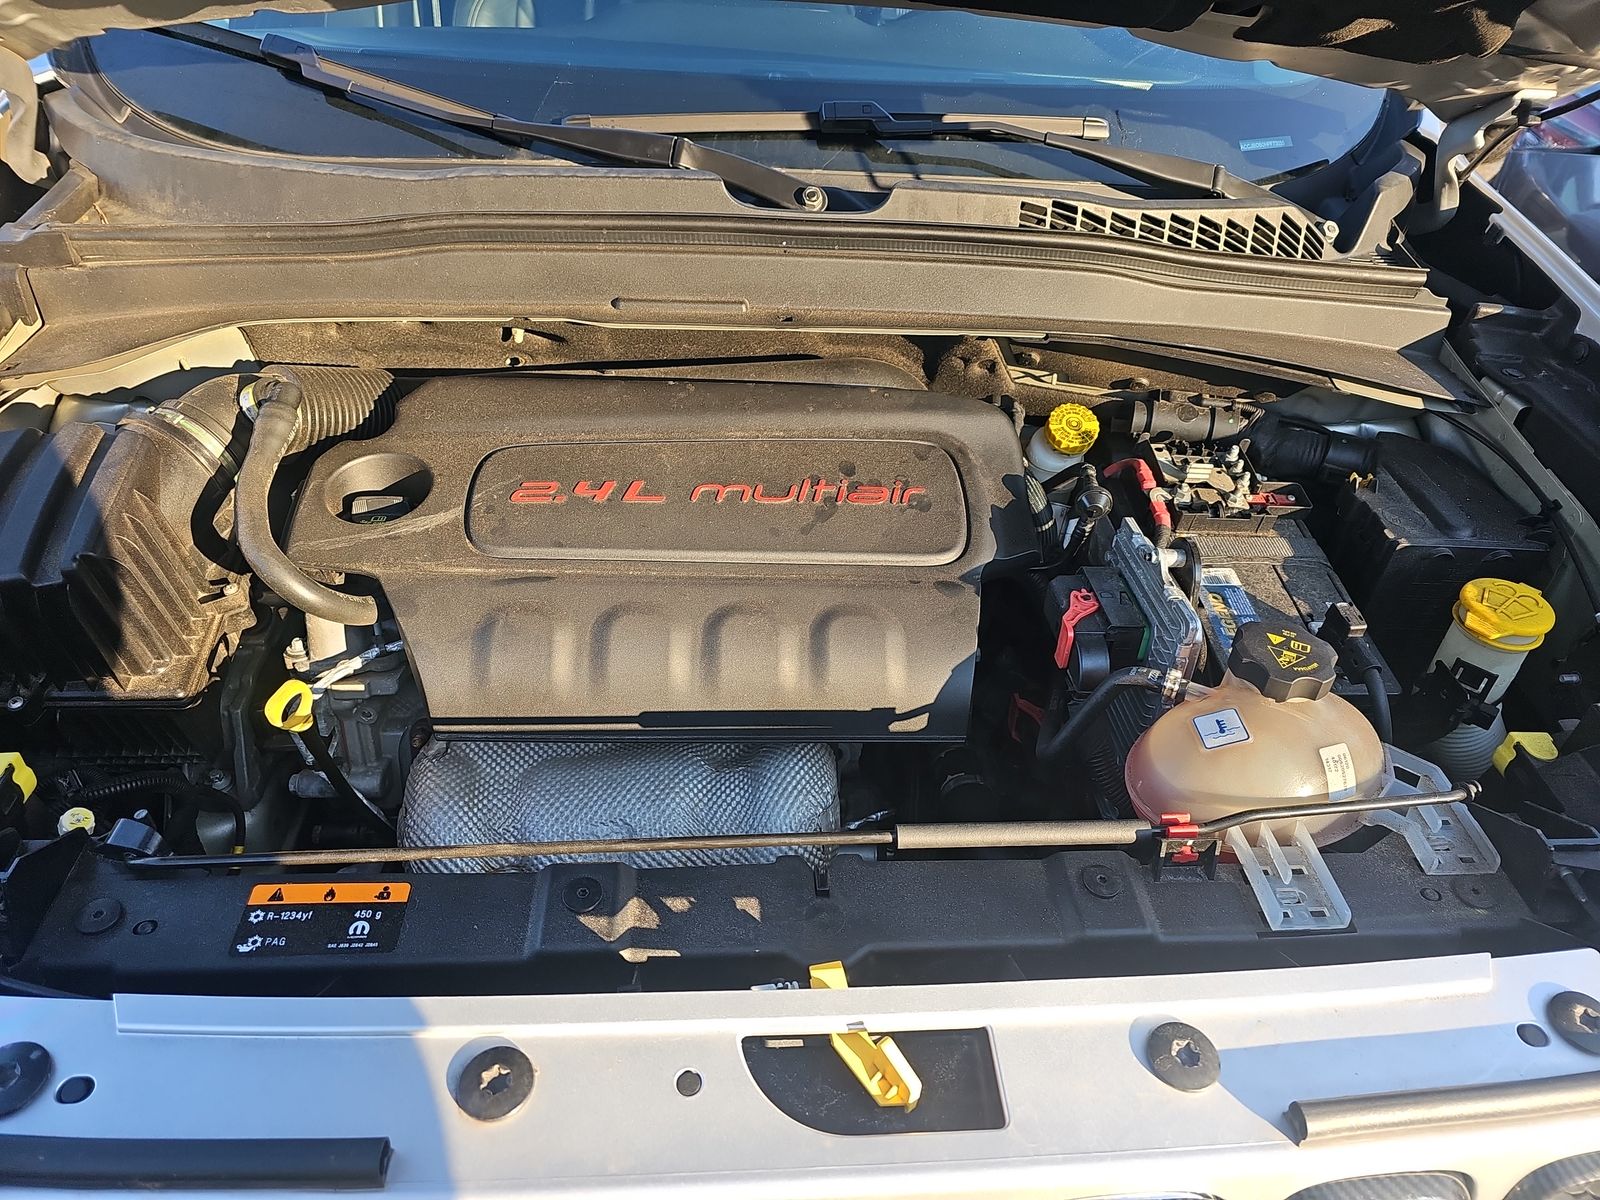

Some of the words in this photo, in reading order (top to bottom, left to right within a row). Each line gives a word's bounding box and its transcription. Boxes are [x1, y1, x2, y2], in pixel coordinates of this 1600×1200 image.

[690, 479, 925, 504] multiair
[266, 910, 314, 922] R-1234yf
[354, 909, 373, 919] 450
[375, 911, 382, 920] g
[264, 936, 287, 946] PAG
